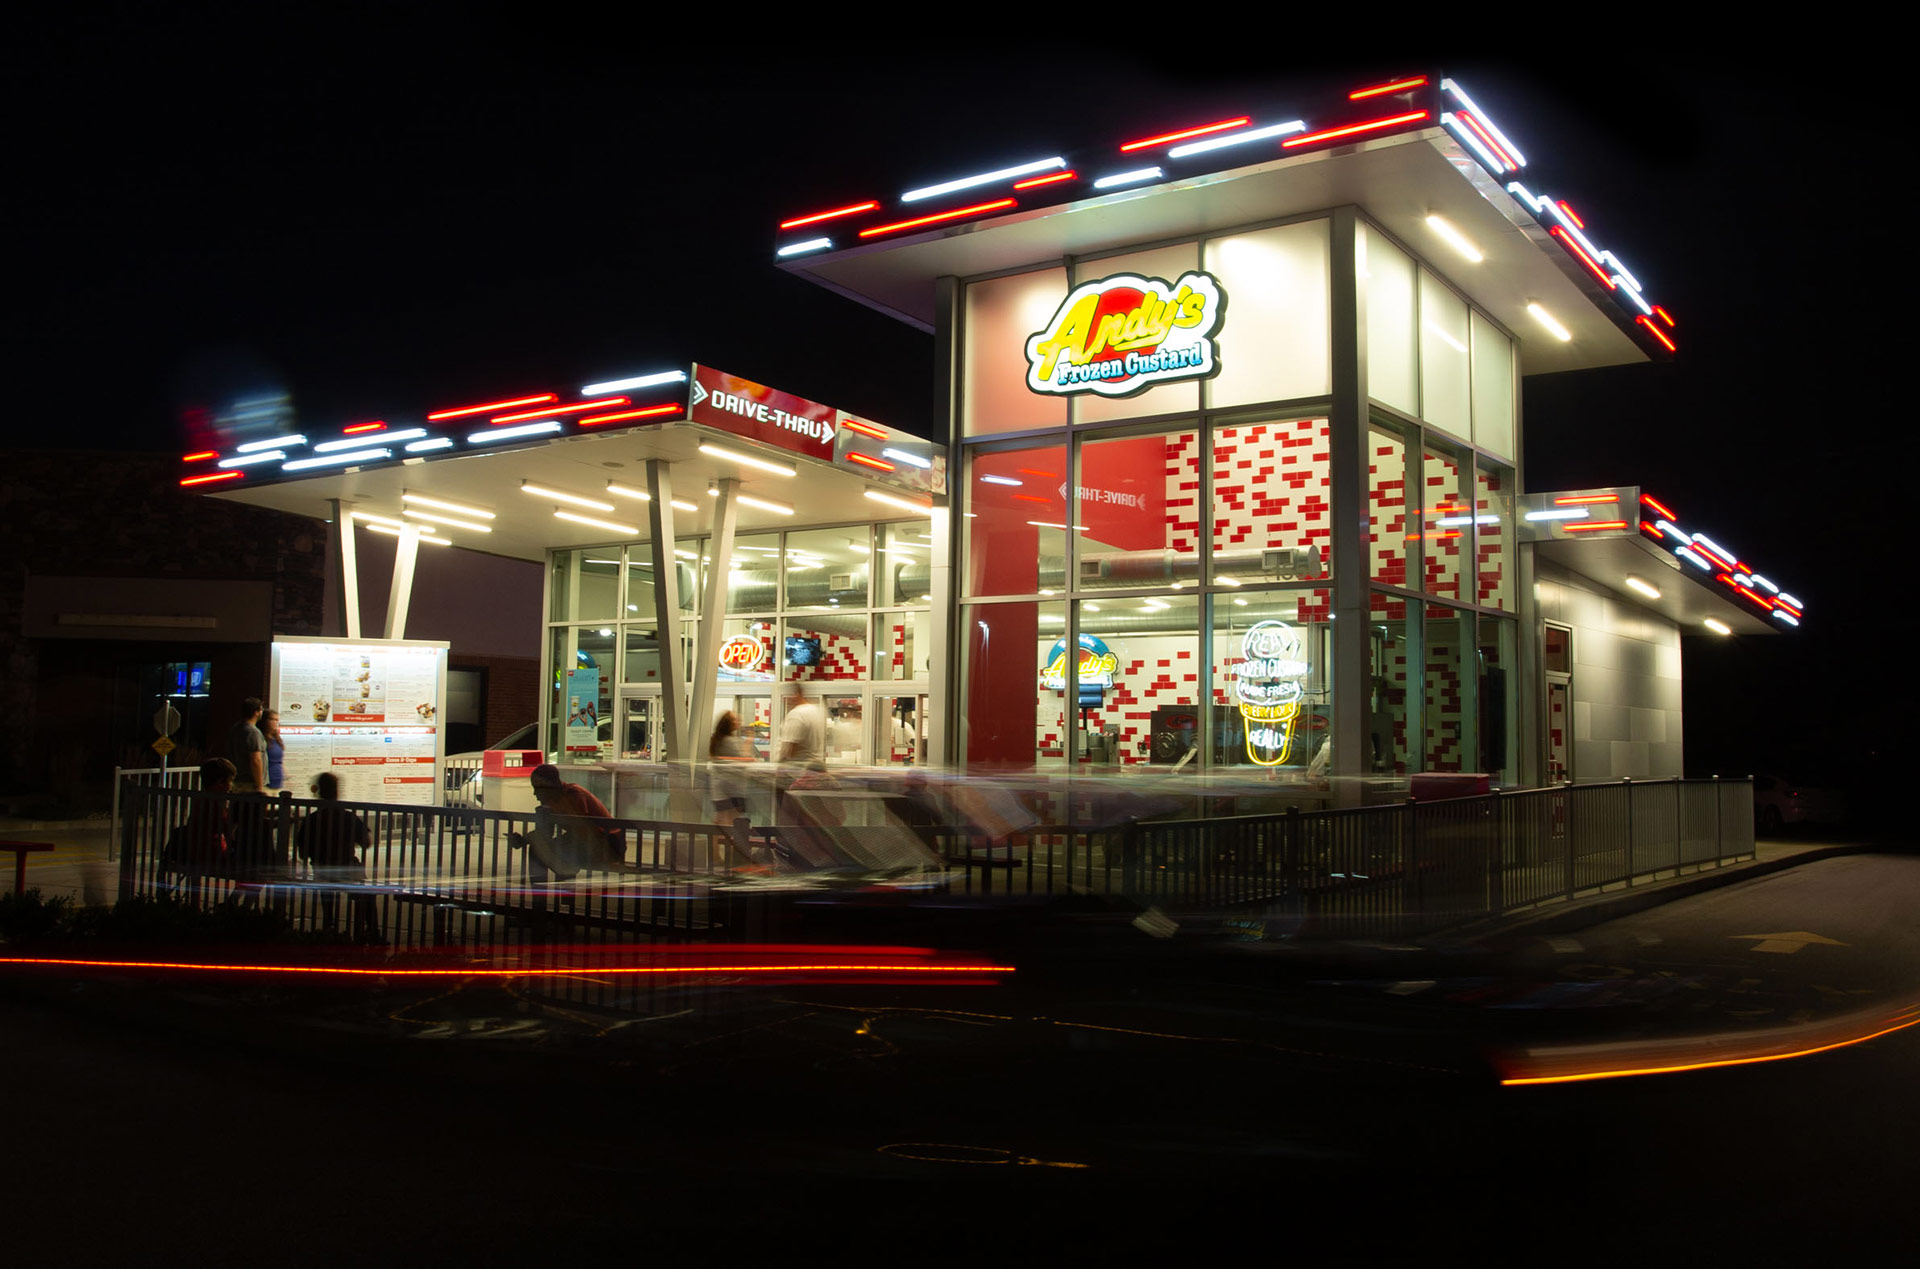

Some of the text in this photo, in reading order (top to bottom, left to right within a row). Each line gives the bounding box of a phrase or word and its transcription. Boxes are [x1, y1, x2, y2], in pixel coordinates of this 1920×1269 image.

[1037, 284, 1206, 381] Andy's
[1057, 342, 1203, 385] Frozen Custard
[711, 390, 821, 438] DRIVE-THRU
[724, 645, 758, 662] OPEN
[1042, 652, 1116, 686] Ady's
[1231, 660, 1266, 678] FROZEN
[1267, 683, 1297, 698] FRESH
[1243, 704, 1269, 717] EVERY
[1249, 728, 1286, 749] REALLY
